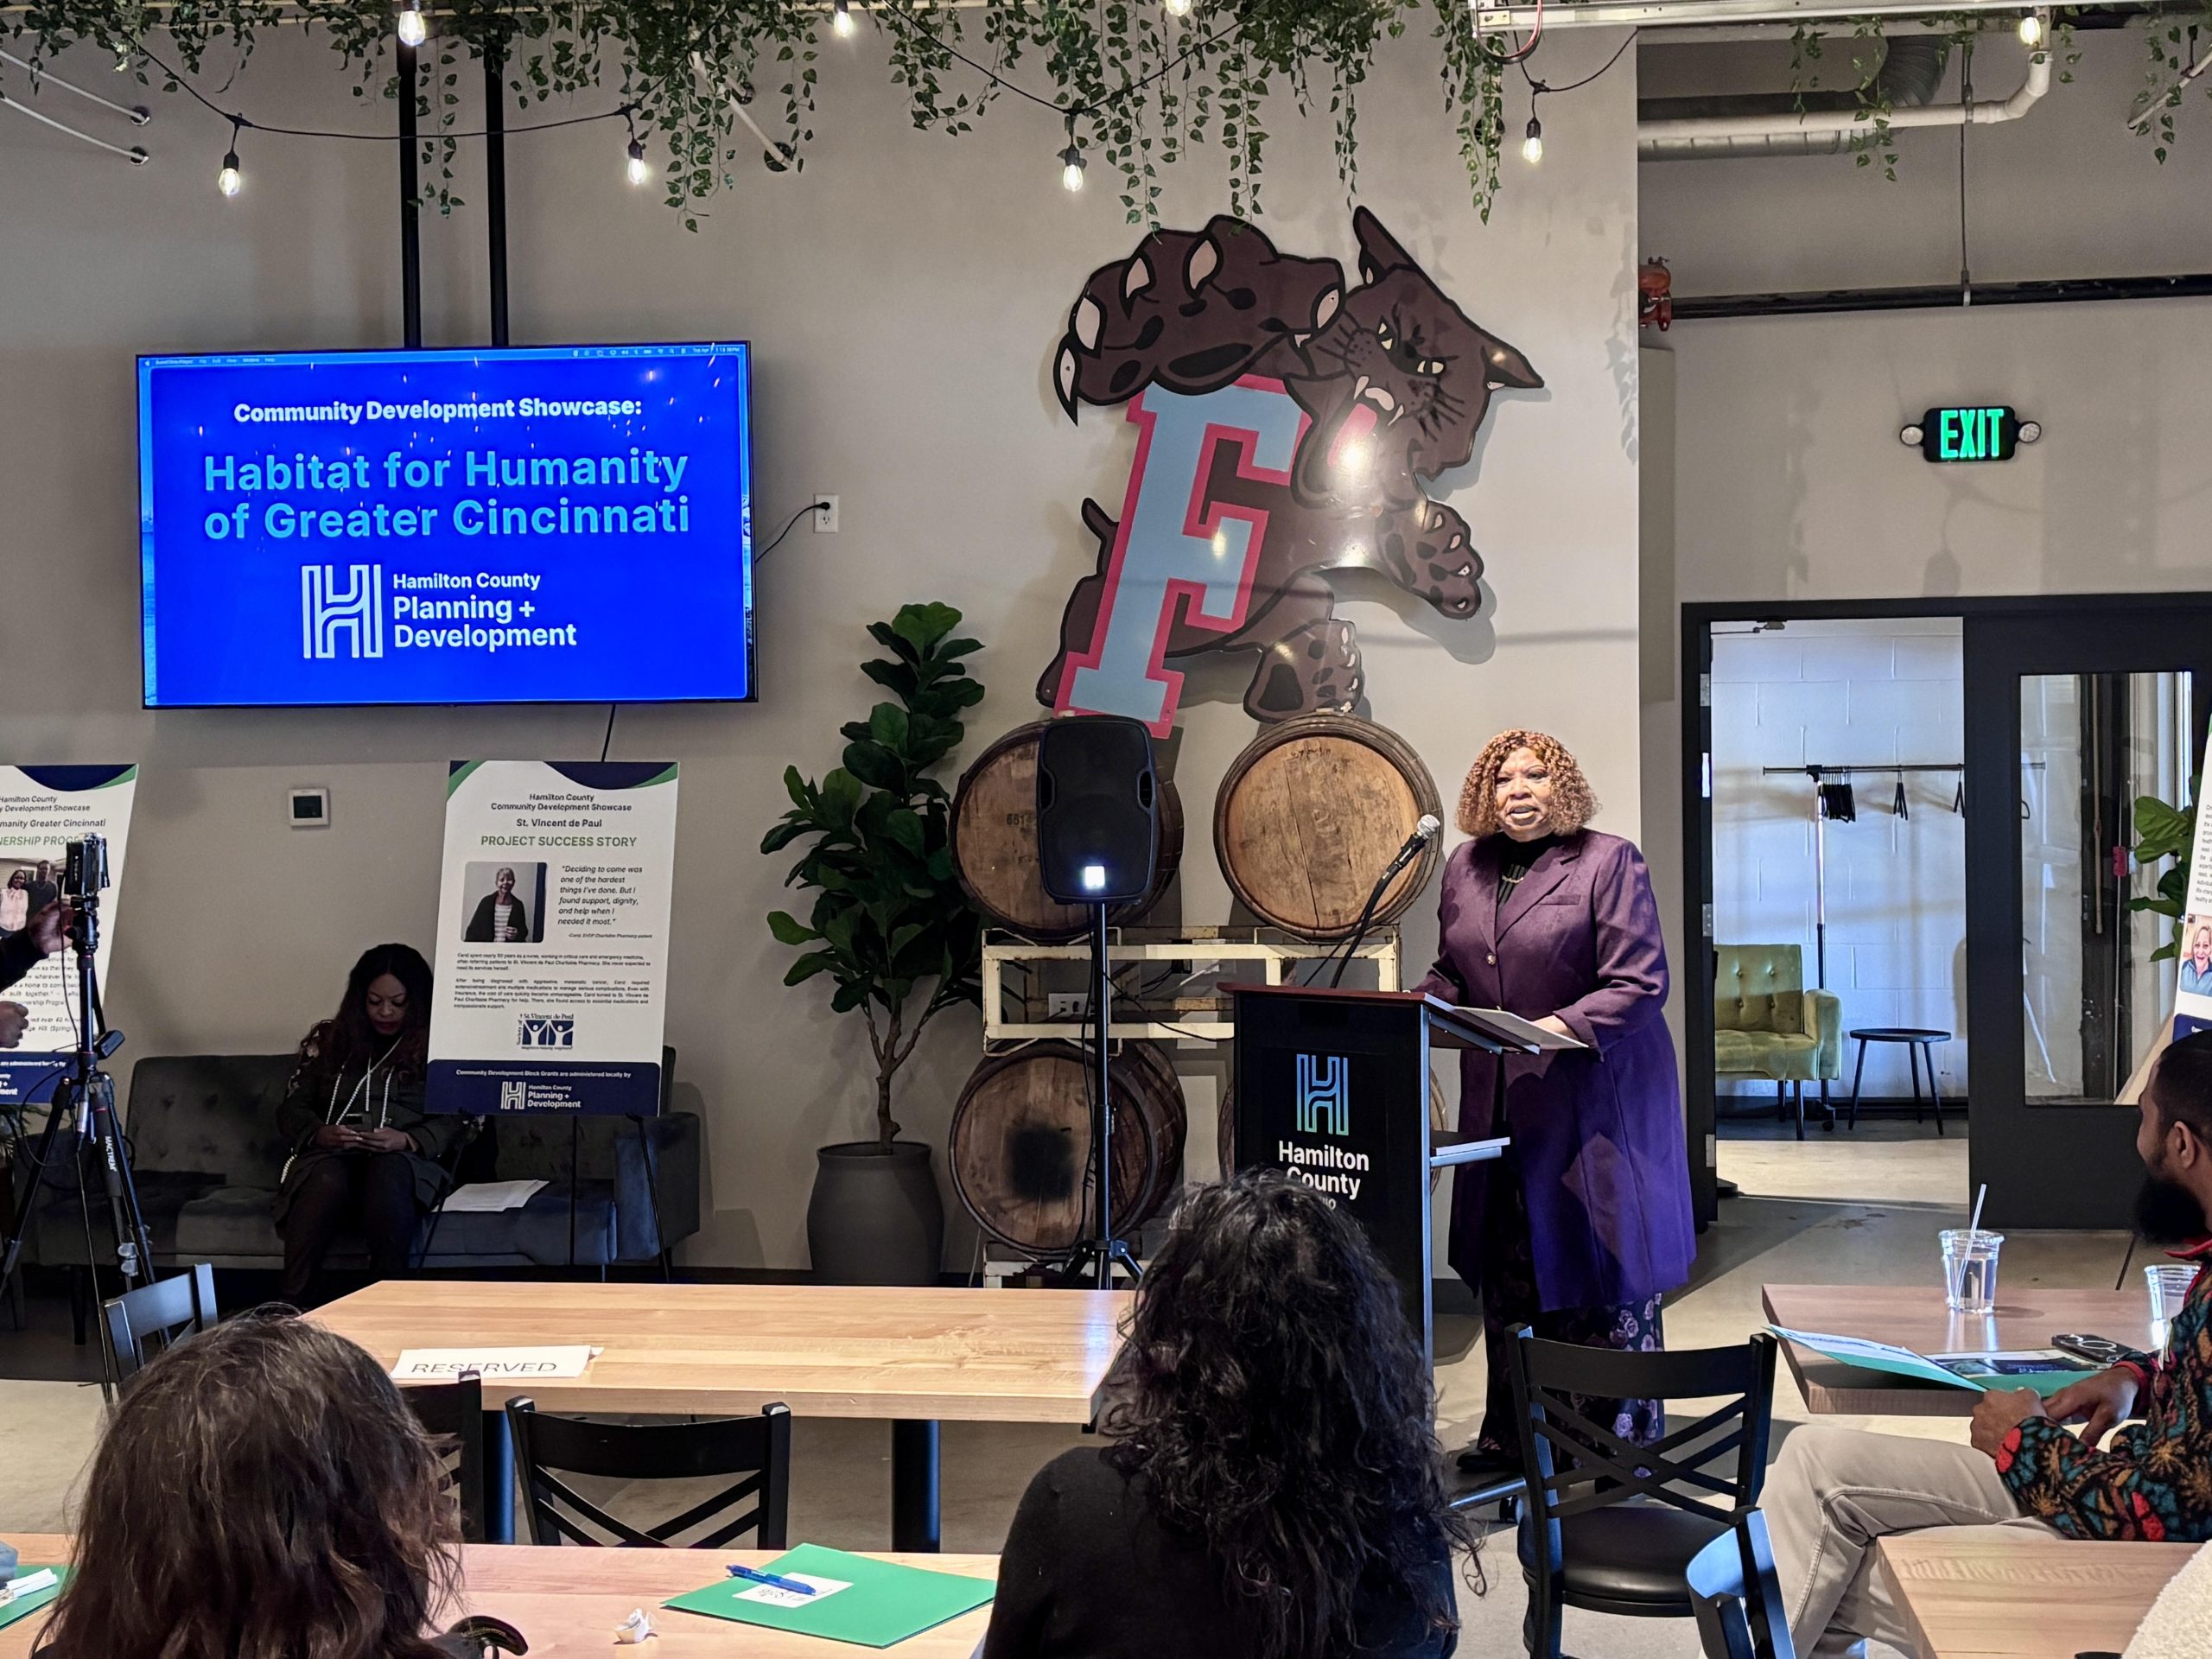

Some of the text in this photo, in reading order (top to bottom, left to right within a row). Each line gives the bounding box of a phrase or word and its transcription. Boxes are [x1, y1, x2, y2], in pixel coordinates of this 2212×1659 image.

[234, 397, 642, 425] Community Development Showcase:
[1940, 409, 2004, 459] EXIT
[204, 448, 688, 493] Habitat for Humanity
[204, 496, 690, 539] of Greater Cincinnati
[393, 572, 541, 591] Hamilton County
[394, 595, 535, 623] Planning +
[394, 625, 577, 653] Development
[529, 793, 594, 803] Hamilton County
[5, 804, 52, 813] Development
[491, 802, 632, 812] Community Development Showcase
[0, 819, 28, 829] manity
[63, 818, 106, 827] Cincinnati
[516, 818, 602, 828] St. Vincent de Paul
[480, 836, 637, 847] PROJECT SUCCESS STORY
[562, 865, 596, 874] "Deciding
[528, 1090, 563, 1101] Planning
[527, 1100, 581, 1109] Development
[1279, 1140, 1370, 1172] Hamilton
[1287, 1166, 1361, 1200] County
[411, 1362, 557, 1373] RESERVED
